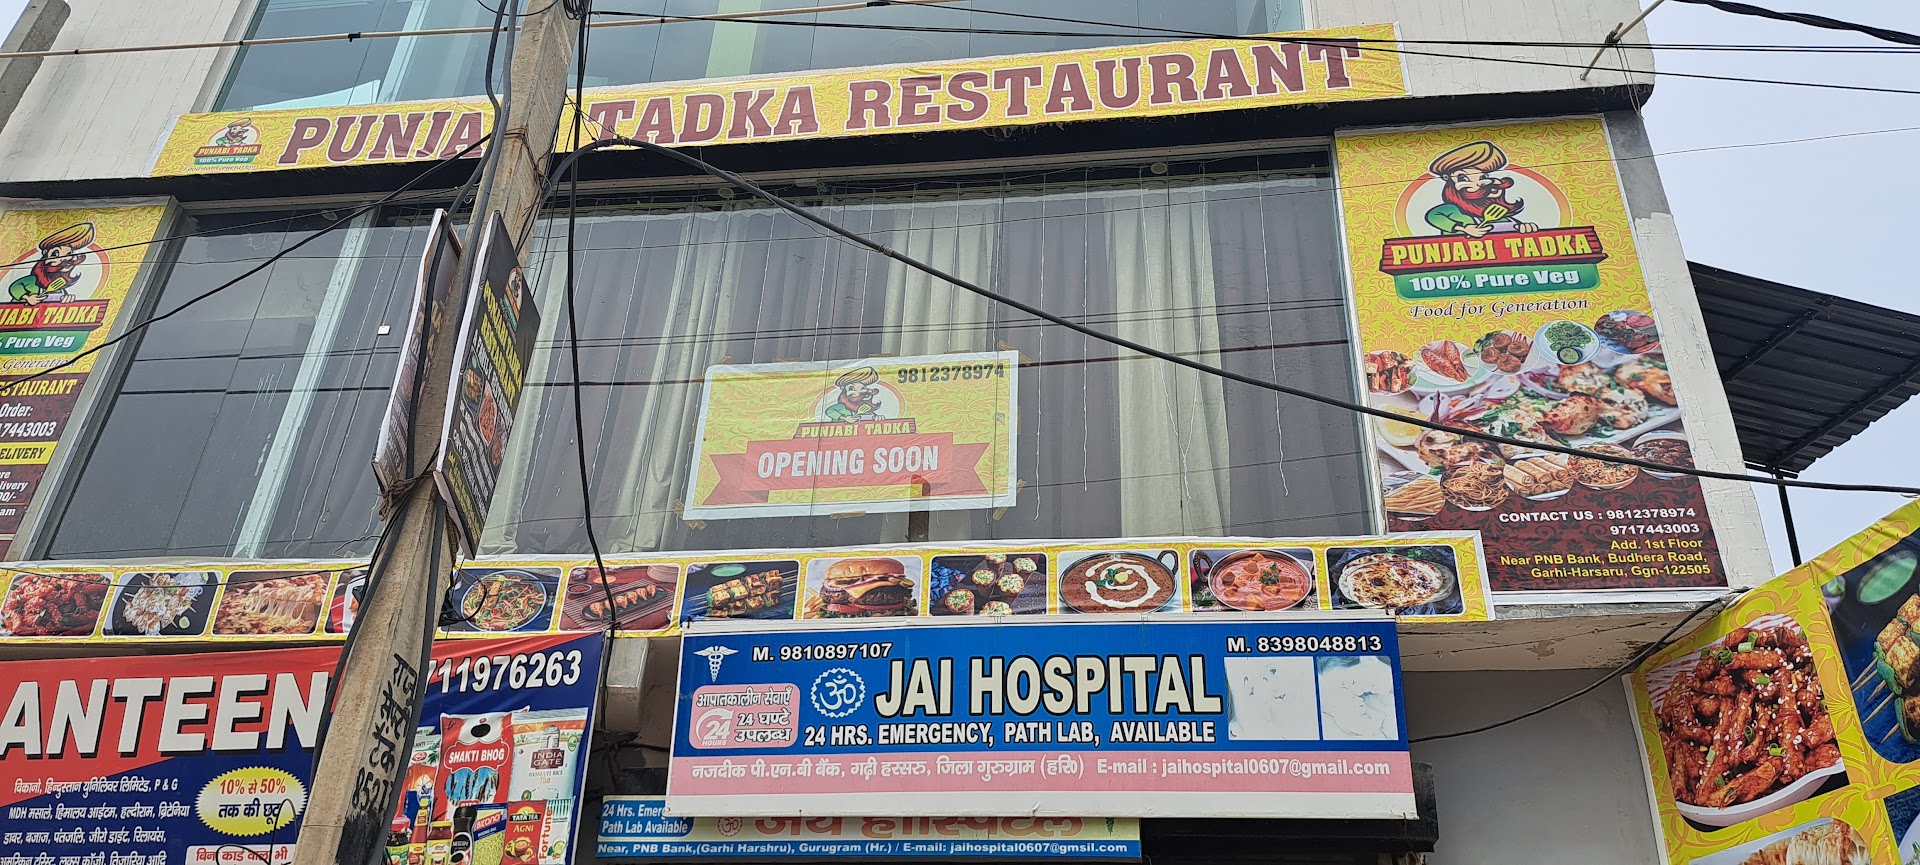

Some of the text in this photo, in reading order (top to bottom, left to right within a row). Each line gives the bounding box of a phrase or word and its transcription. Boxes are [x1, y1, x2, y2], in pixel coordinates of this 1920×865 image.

[277, 38, 1362, 166] PUNJA TADKA RESTAURANT
[199, 145, 259, 156] PUNJABI TADKA
[1390, 233, 1593, 265] PUNJABI TADKA
[1409, 270, 1580, 292] 100% Pure Veg
[44, 305, 100, 325] TADKA
[1409, 297, 1590, 321] Food for Generation
[5, 336, 42, 348] Pure
[44, 335, 75, 348] Veg
[898, 363, 1005, 385] 9812378974
[0, 402, 33, 417] Order:
[0, 421, 57, 437] 7443003
[801, 421, 912, 438] PUNJABI TADKA
[757, 445, 939, 478] OPENING SOON
[1499, 511, 1569, 523] CONTACT
[1574, 510, 1594, 521] US
[1607, 507, 1696, 521] 9812378974
[1610, 523, 1700, 536] 9717443003
[1610, 538, 1704, 551] Add. 1st Floor
[1500, 551, 1708, 566] Near PNB Bank, Budhera Road,
[1531, 564, 1711, 579] Garhi-Harsaru, Ggn-122505
[752, 642, 893, 662] M. 9810897107
[1227, 634, 1383, 653] M. 8398048813
[874, 654, 1224, 718] JAI HOSPITAL
[696, 685, 763, 707] आपातकालीन
[0, 671, 329, 757] ANTEEN
[737, 707, 792, 726] 24 घण्टे
[704, 720, 731, 740] 24
[734, 727, 792, 744] उपलब्ध
[804, 720, 1216, 749] 24 HRS. EMERGENCY, PATH LAB, AVAILABLE
[702, 739, 727, 747] HOURS
[449, 747, 505, 764] SHAKTI BHOG
[533, 759, 562, 767] GATE
[534, 751, 563, 760] INDIA
[692, 758, 748, 779] नजदीक
[815, 757, 846, 779] बैंक,
[936, 755, 973, 776] जिला
[977, 759, 1036, 782] गुरुग्राम
[1097, 758, 1148, 775] E-mail
[1161, 758, 1391, 779] jaihospital0607@gmail.com
[154, 778, 161, 792] P
[162, 777, 169, 791] &
[171, 777, 179, 791] G
[220, 777, 286, 796] 10% से 50%
[8, 806, 27, 820] MDH
[54, 802, 87, 820] हिमालय
[218, 803, 241, 818] तक
[243, 797, 261, 818] की
[602, 803, 614, 818] 24
[616, 803, 635, 818] Hrs.
[512, 813, 538, 822] TATA TEA
[513, 824, 534, 833] AGNI
[538, 809, 553, 860] Fortune
[602, 820, 688, 834] Path Lab Available
[274, 846, 288, 861] भी
[597, 843, 629, 855] Near,
[633, 843, 658, 853] PNB
[737, 842, 795, 855] Harshru),
[798, 842, 861, 856] Gurugram
[865, 841, 892, 854] (Hr.)
[903, 842, 947, 853] E-mail:
[950, 841, 1128, 855] jaihospital0607@gmsil.com
